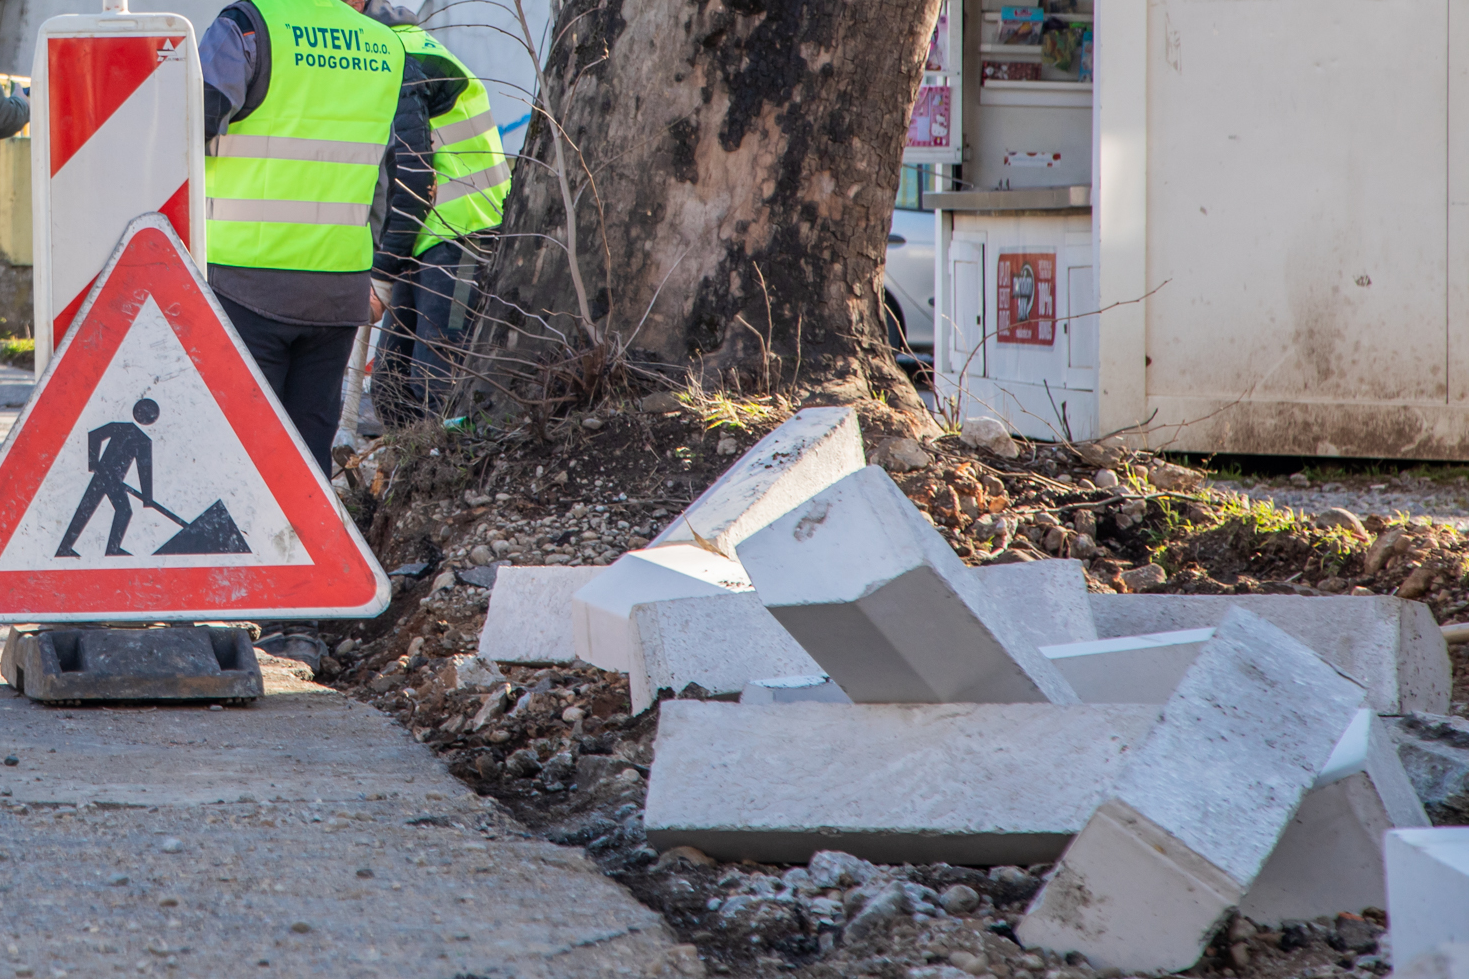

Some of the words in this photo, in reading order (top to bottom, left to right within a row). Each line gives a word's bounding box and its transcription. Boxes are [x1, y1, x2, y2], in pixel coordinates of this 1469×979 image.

[285, 24, 364, 51] "PUTEVI"
[365, 42, 390, 55] D.O.O.
[295, 53, 391, 72] PODGORICA
